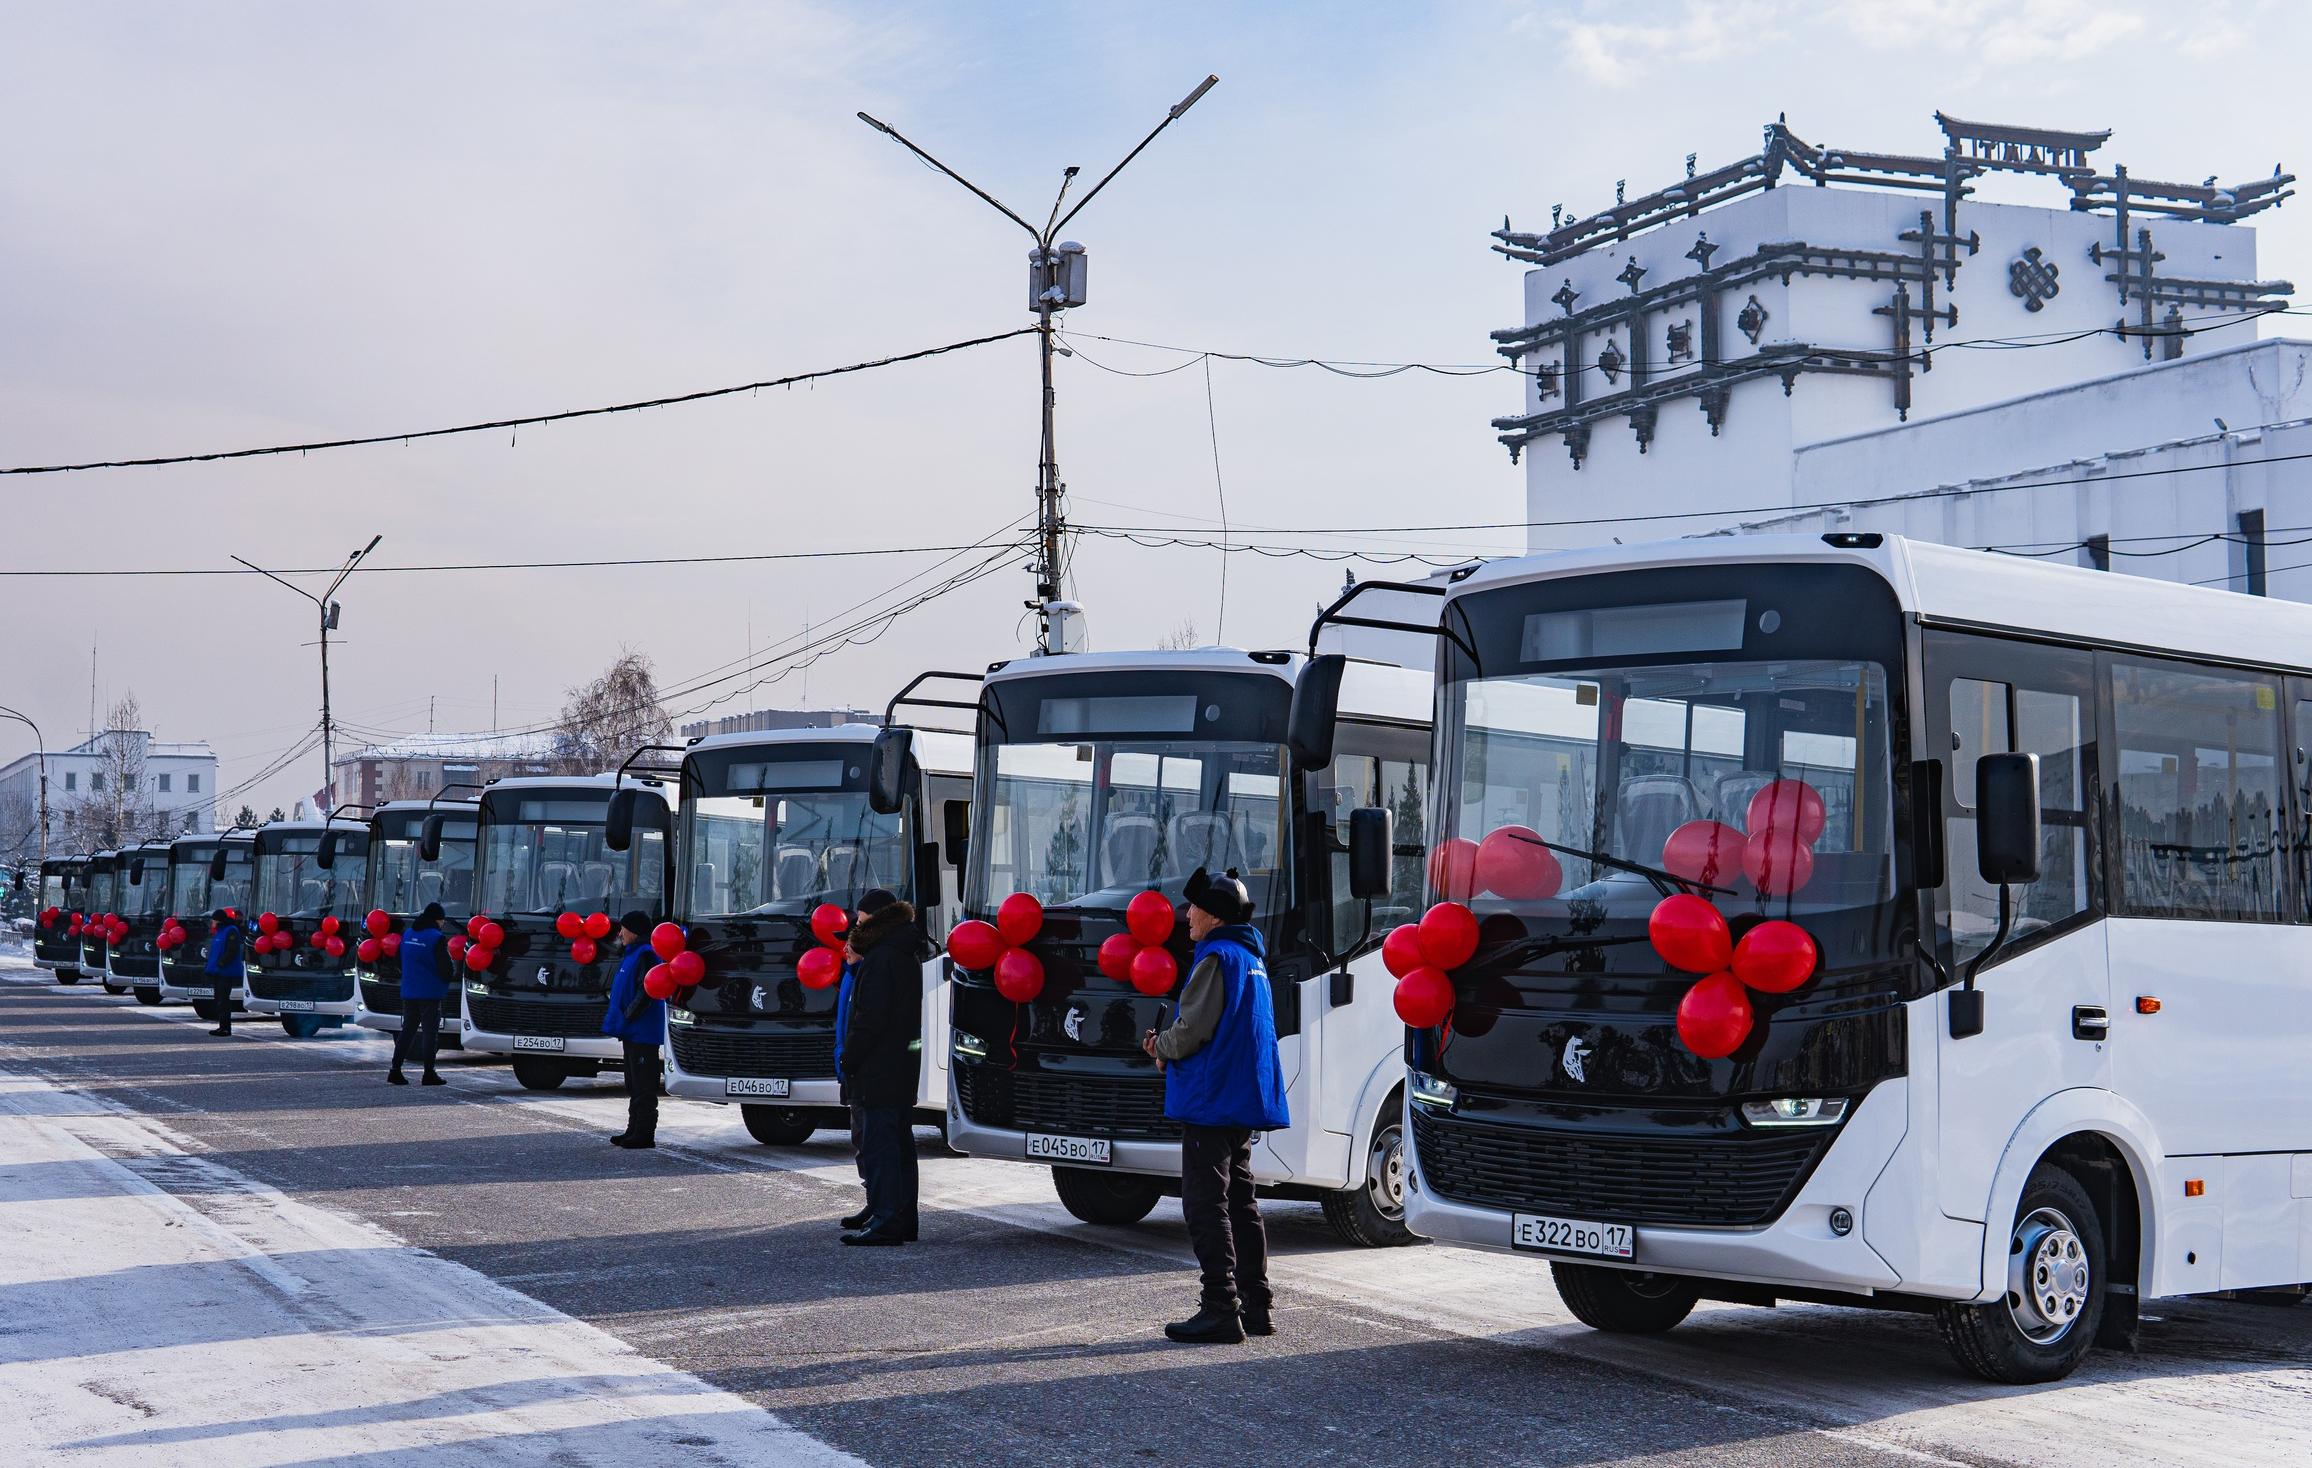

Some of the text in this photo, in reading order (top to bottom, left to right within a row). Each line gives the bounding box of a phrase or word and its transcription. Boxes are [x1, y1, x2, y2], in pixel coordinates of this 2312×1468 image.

[517, 1037, 551, 1048] Е254ВО
[730, 1080, 785, 1093] Е046ВО 17
[1032, 1137, 1105, 1157] Е045ВО 17
[1522, 1220, 1626, 1250] Е322ВО 17
